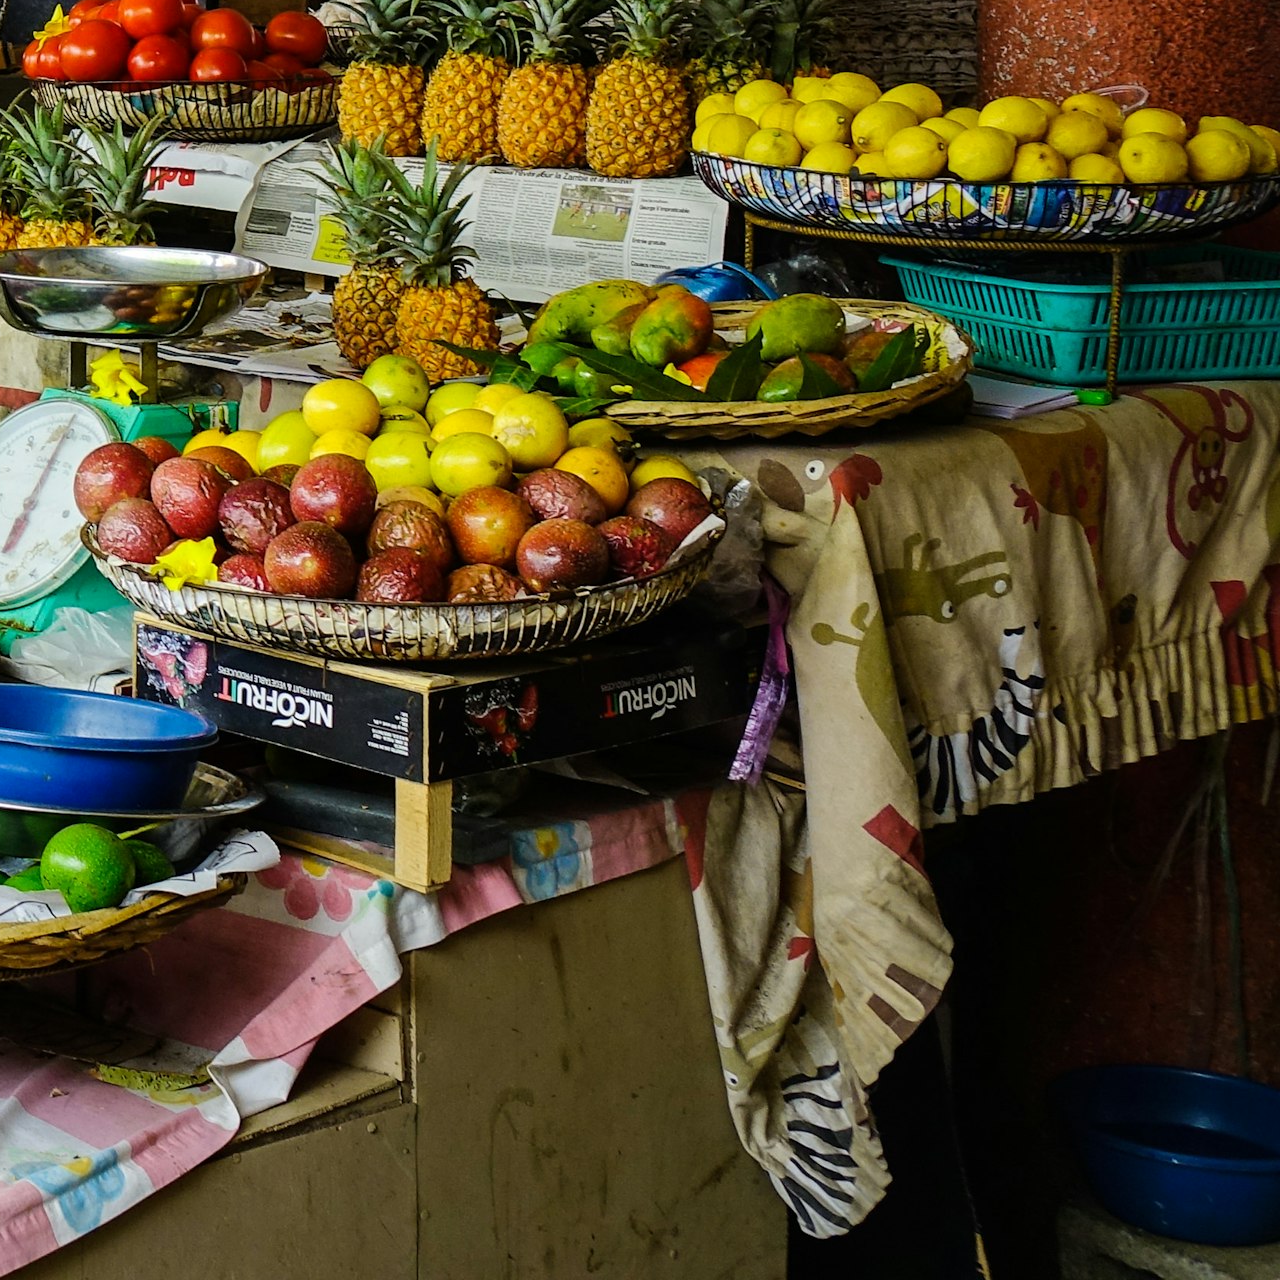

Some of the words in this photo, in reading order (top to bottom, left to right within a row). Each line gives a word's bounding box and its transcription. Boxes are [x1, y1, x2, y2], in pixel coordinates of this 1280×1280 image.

[218, 665, 253, 682] PRODUCERS
[254, 673, 287, 690] VEGETABLE
[293, 683, 310, 696] FRUIT
[310, 688, 333, 702] ITALIAN
[604, 676, 696, 718] NICOFRUIT
[217, 677, 333, 728] NICOFRUIT
